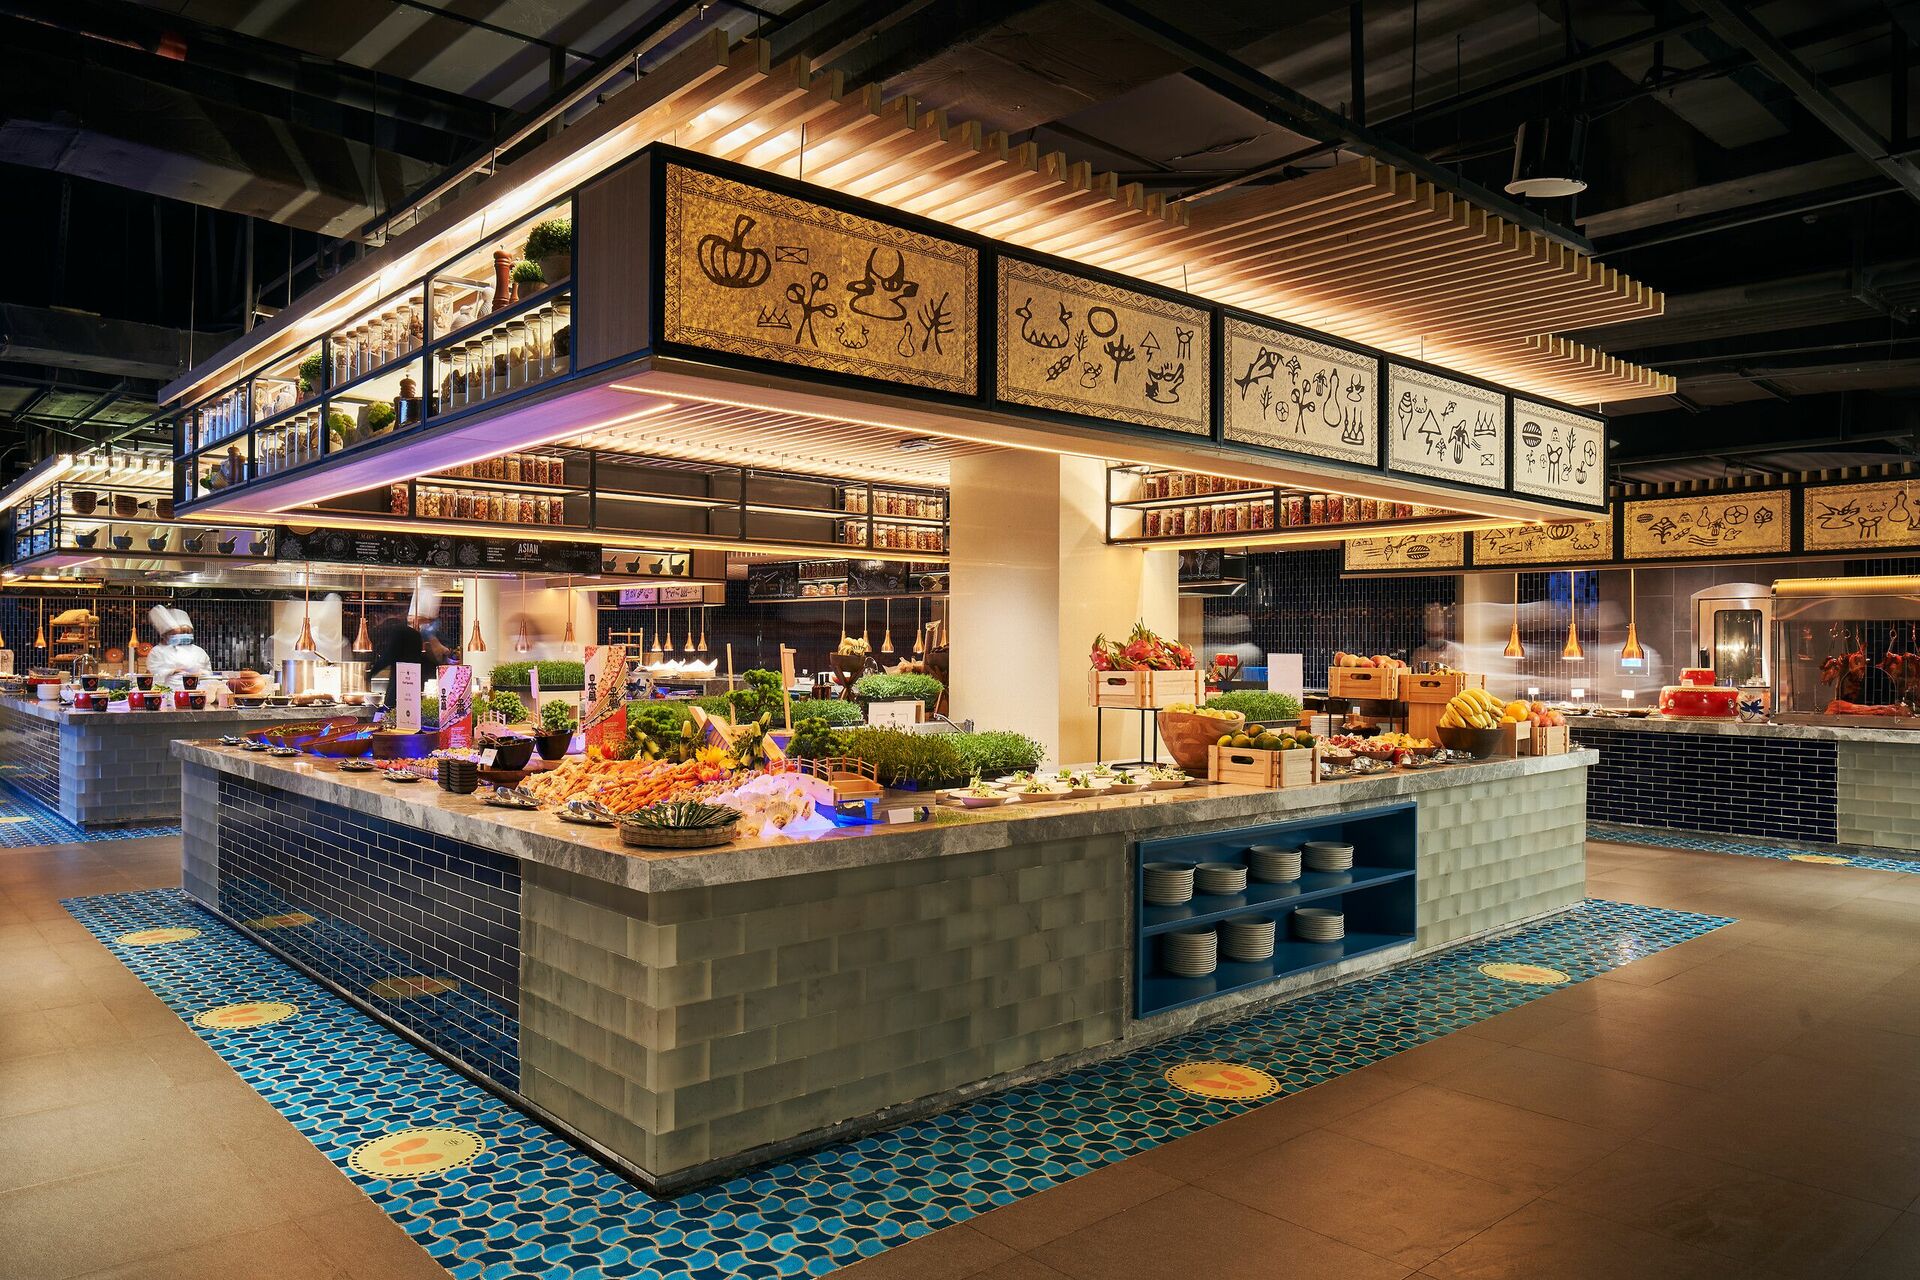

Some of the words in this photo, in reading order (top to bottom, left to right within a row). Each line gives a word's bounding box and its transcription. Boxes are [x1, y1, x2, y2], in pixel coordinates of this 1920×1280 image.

[518, 543, 539, 555] ASIAN
[588, 674, 597, 702] 日本盛
